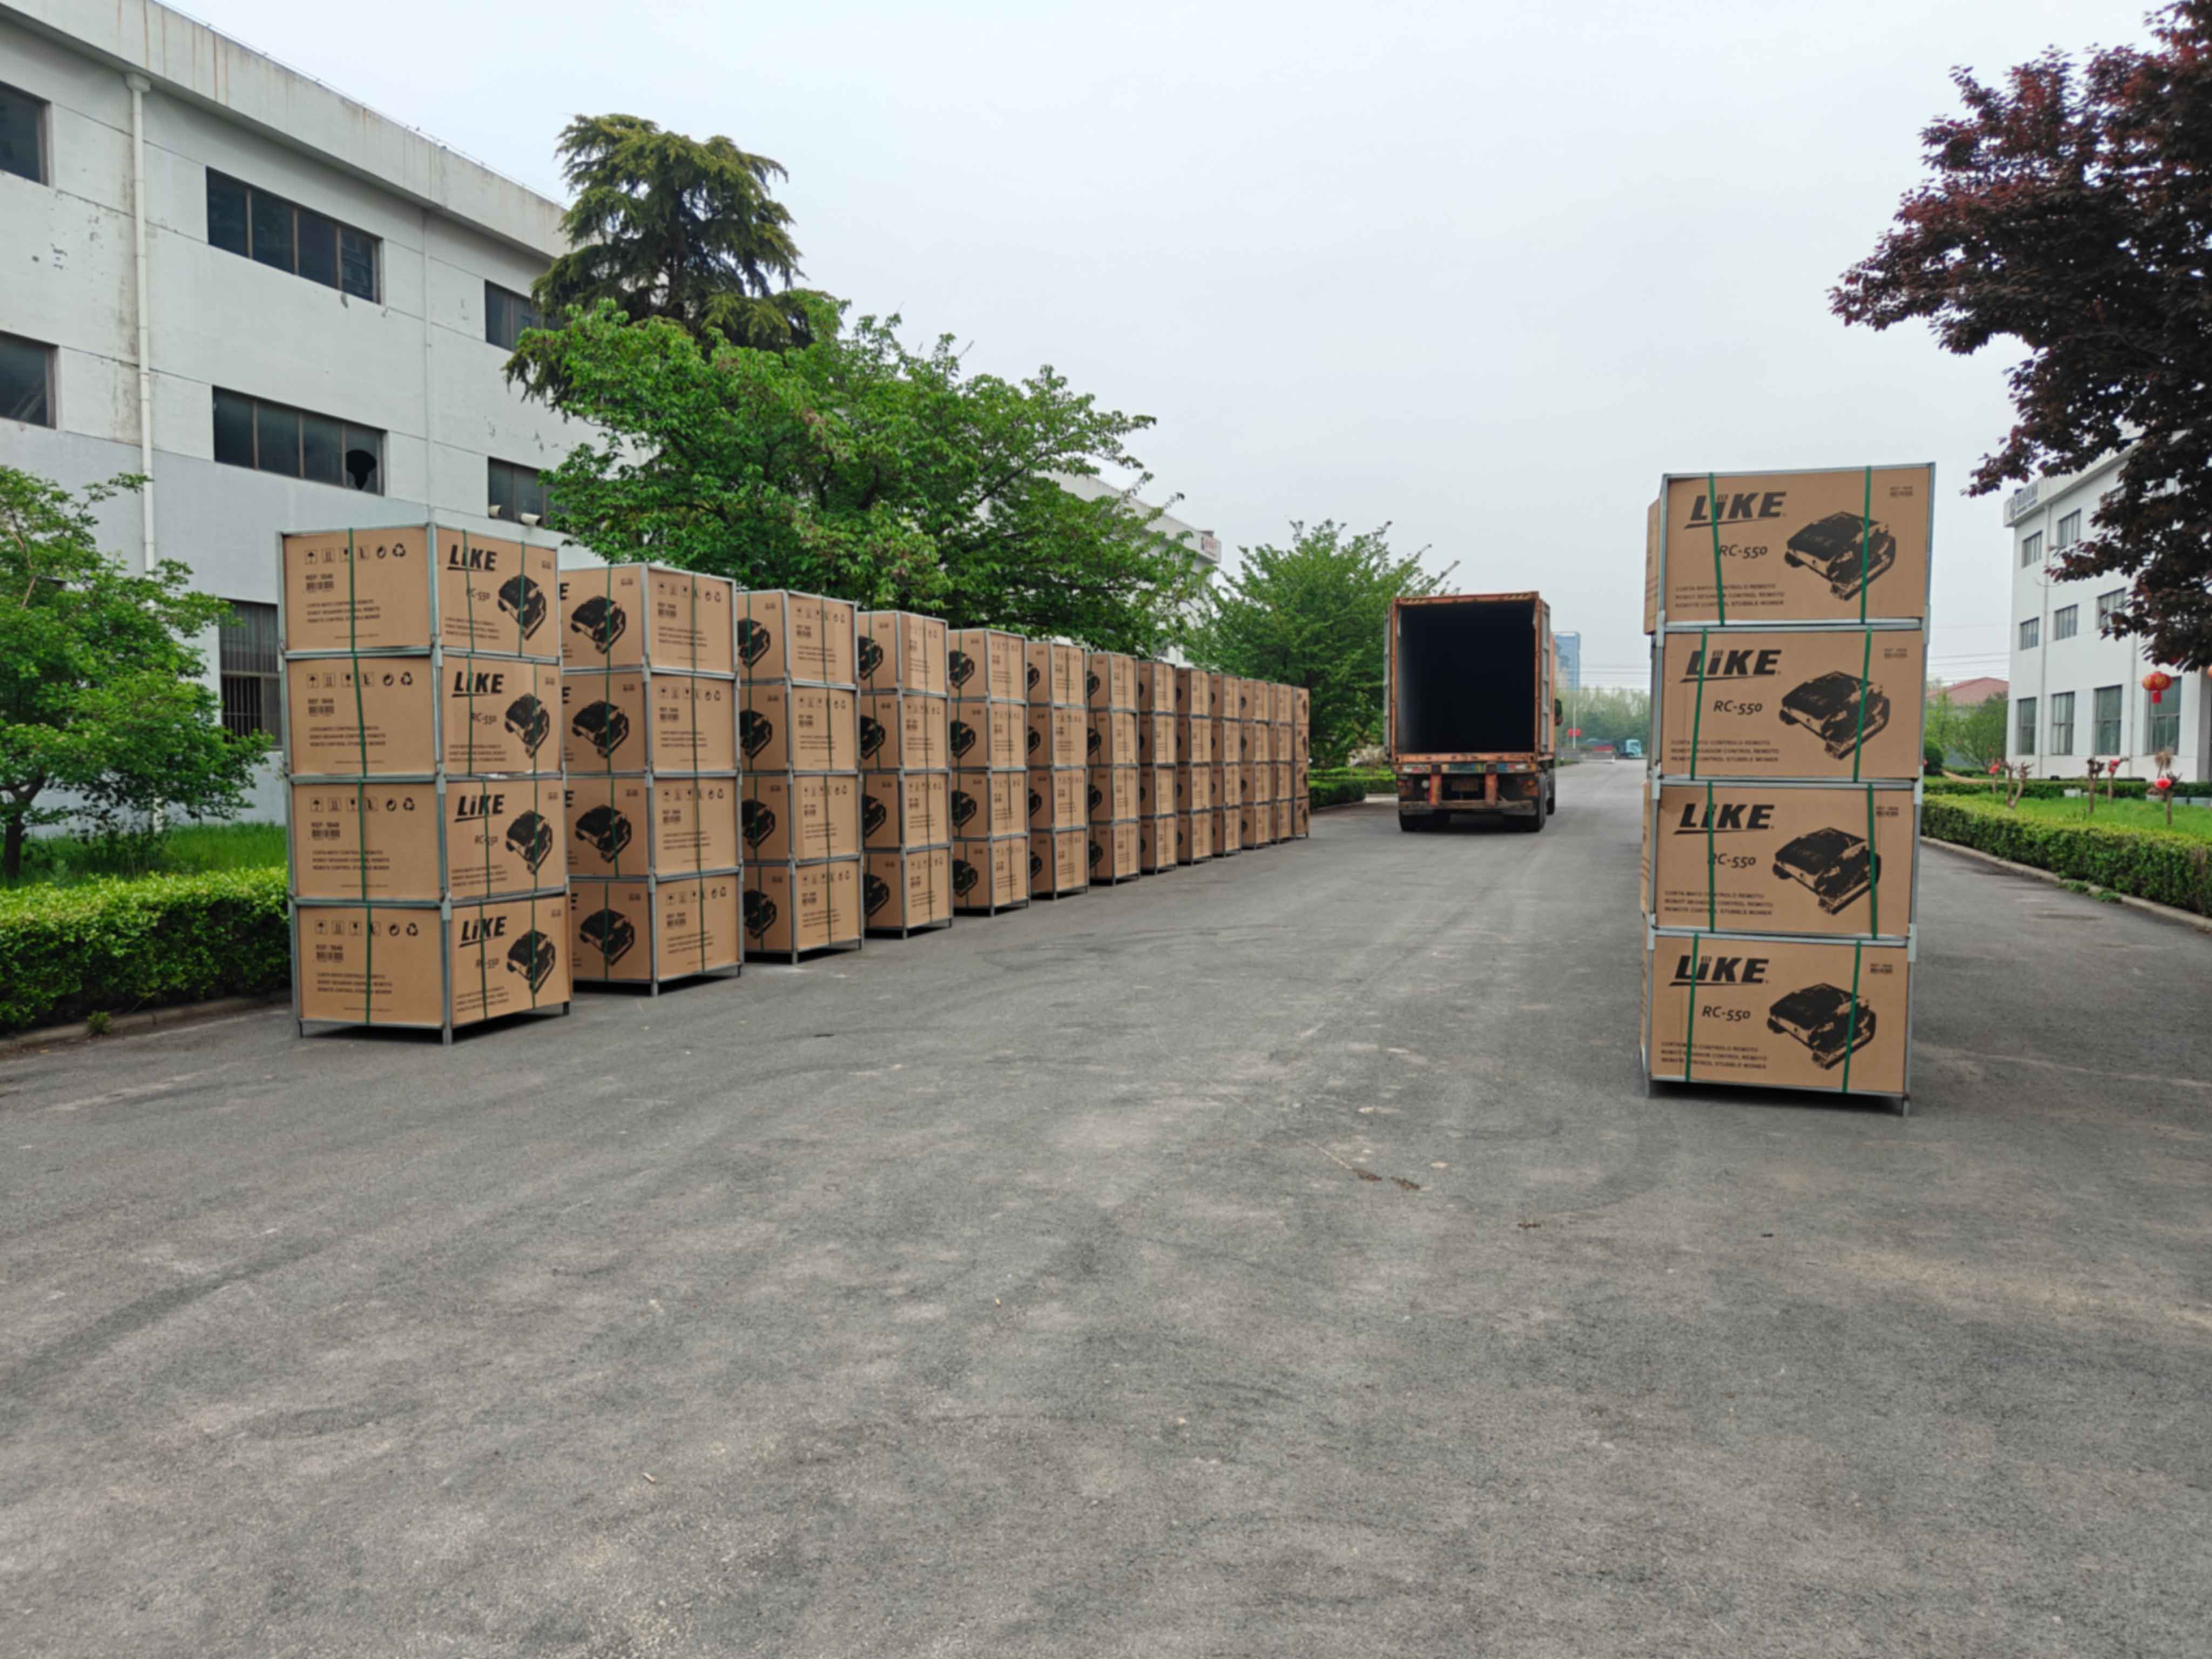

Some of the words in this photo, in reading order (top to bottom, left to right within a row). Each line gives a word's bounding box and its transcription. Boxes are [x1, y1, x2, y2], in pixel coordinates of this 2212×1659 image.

[1718, 544, 1768, 559] RC-550
[1714, 700, 1763, 715] RC-550
[1702, 1005, 1751, 1022] RC-550
